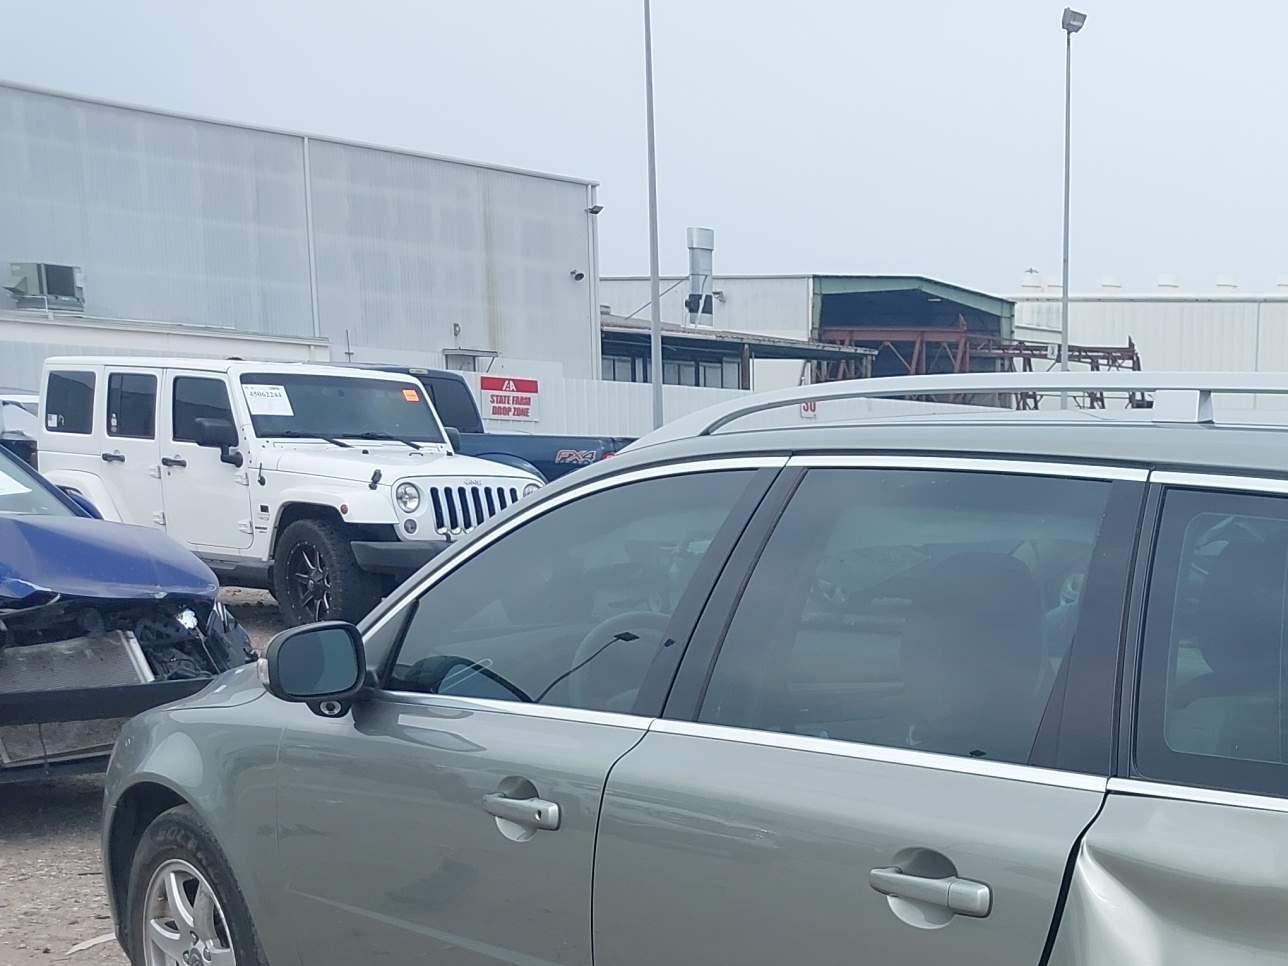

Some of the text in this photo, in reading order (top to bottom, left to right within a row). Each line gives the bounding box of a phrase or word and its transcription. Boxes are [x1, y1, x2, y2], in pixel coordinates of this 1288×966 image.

[490, 394, 531, 405] STATE FARM
[492, 405, 530, 417] DROP ZONE
[555, 449, 596, 464] FX4
